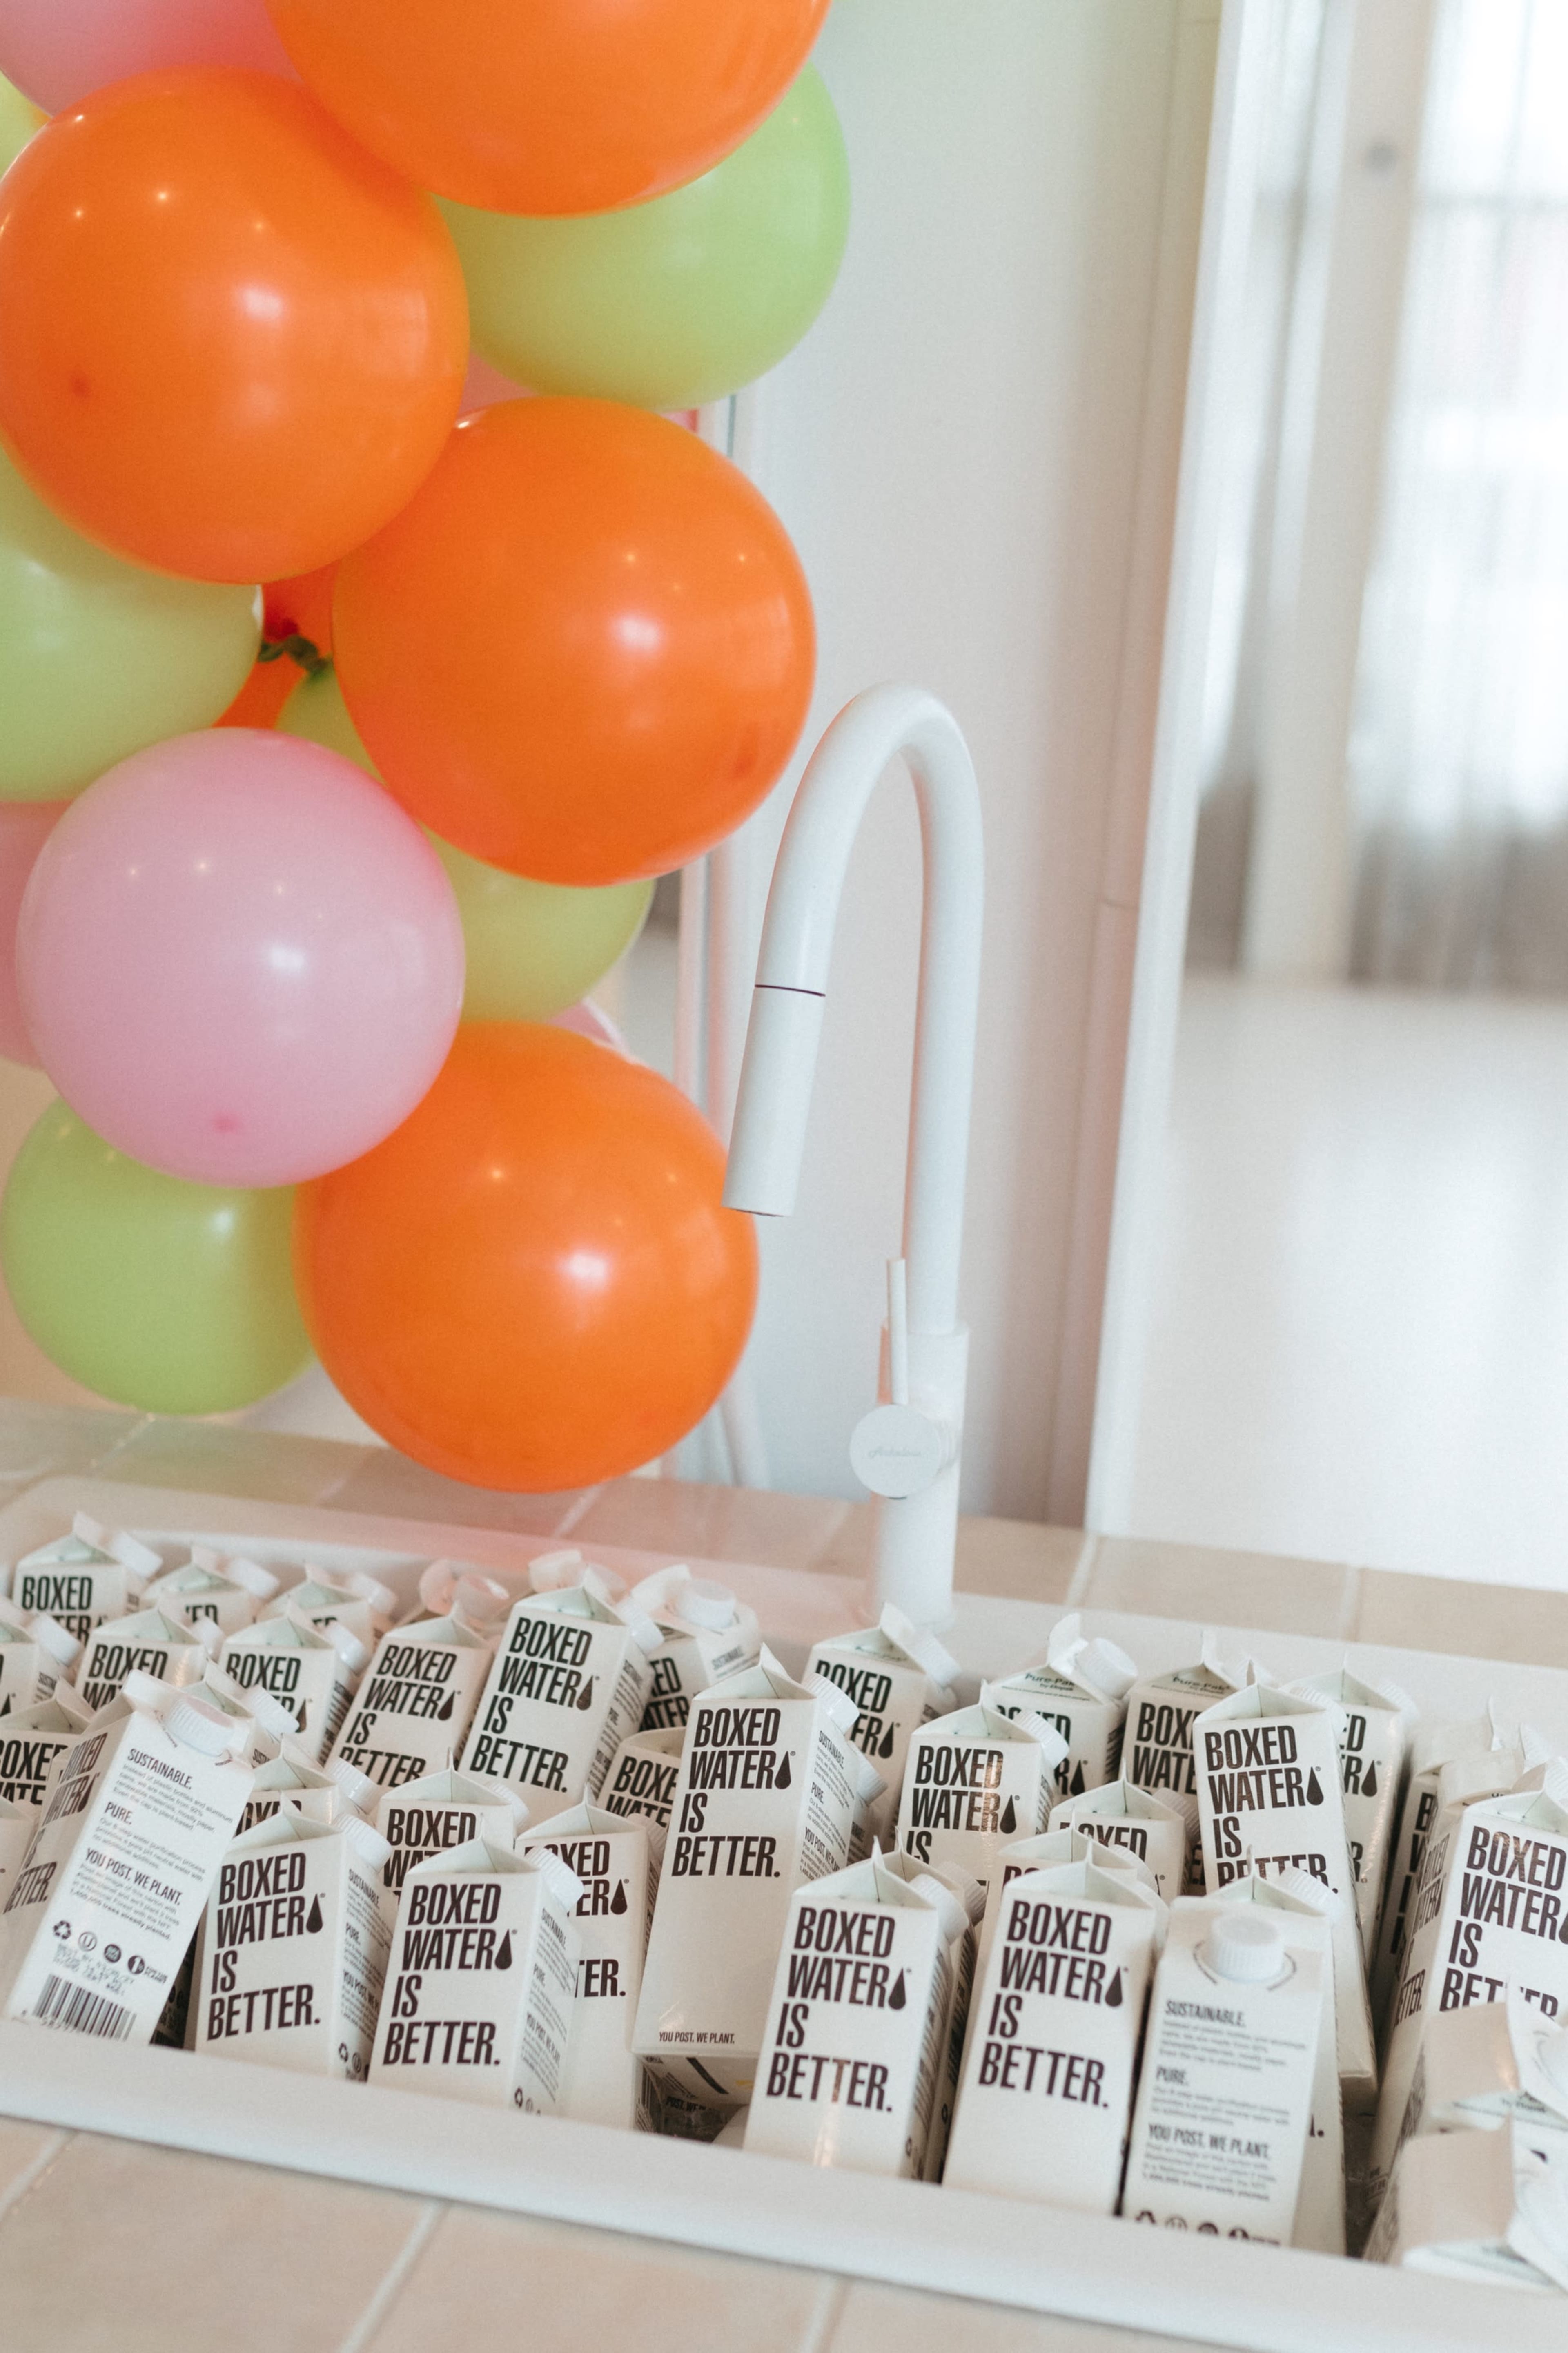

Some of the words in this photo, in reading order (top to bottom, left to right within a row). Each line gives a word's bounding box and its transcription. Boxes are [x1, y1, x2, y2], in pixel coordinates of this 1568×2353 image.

[22, 1576, 92, 1610] BOXED
[376, 1644, 457, 1683] BOXED
[509, 1617, 592, 1666] BOXED
[363, 1678, 444, 1719] WATER
[497, 1655, 582, 1708] WATER
[345, 1712, 376, 1746] IS
[483, 1695, 514, 1734] IS
[694, 1708, 781, 1747] BOXED
[127, 1748, 196, 1790] SUSTAINABLE.
[470, 1735, 568, 1793] BETTER.
[689, 1750, 776, 1790] WATER
[915, 1745, 1004, 1789] BOXED
[1204, 1726, 1298, 1771] BOXED
[612, 1755, 679, 1806] BOXE
[1207, 1767, 1306, 1815] WATER
[104, 1801, 136, 1825] PURE.
[387, 1809, 477, 1848] BOXED
[679, 1793, 708, 1833] IS
[911, 1788, 1000, 1833] WATER
[524, 1841, 610, 1877] XED
[672, 1836, 780, 1878] BETTER.
[1212, 1816, 1242, 1859] IS
[1466, 1826, 1567, 1891] BOXED
[82, 1847, 107, 1868] YOU
[104, 1857, 135, 1882] POST.
[131, 1870, 151, 1889] WE
[148, 1879, 185, 1906] PLANT.
[219, 1853, 306, 1905] BOXED
[217, 1896, 305, 1949] WATER
[407, 1884, 501, 1925] BOXED
[1461, 1873, 1561, 1941] WATER
[402, 1929, 497, 1971] WATER
[794, 1907, 896, 1958] BOXED
[1007, 1900, 1112, 1955] BOXED
[1449, 1920, 1483, 1968] IS
[211, 1950, 238, 1995] IS
[787, 1954, 890, 2008] WATER
[1000, 1946, 1106, 2004] WATER
[207, 1985, 321, 2041] BETTER.
[391, 1974, 423, 2018] IS
[988, 1993, 1023, 2039] IS
[1165, 1999, 1246, 2027] SUSTAINABLE.
[383, 2021, 500, 2066] BETTER.
[659, 2032, 673, 2042] YOU
[675, 2032, 695, 2043] POST.
[697, 2032, 708, 2043] WE
[709, 2033, 735, 2044] PLANT.
[775, 2003, 809, 2049] IS
[766, 2052, 893, 2112] BETTER.
[978, 2041, 1109, 2108] BETTER.
[1156, 2066, 1188, 2086] PURE.
[1148, 2123, 1173, 2141] YOU
[1174, 2128, 1205, 2149] POST.
[1209, 2134, 1227, 2152] WE
[1230, 2139, 1271, 2160] PLANT.
